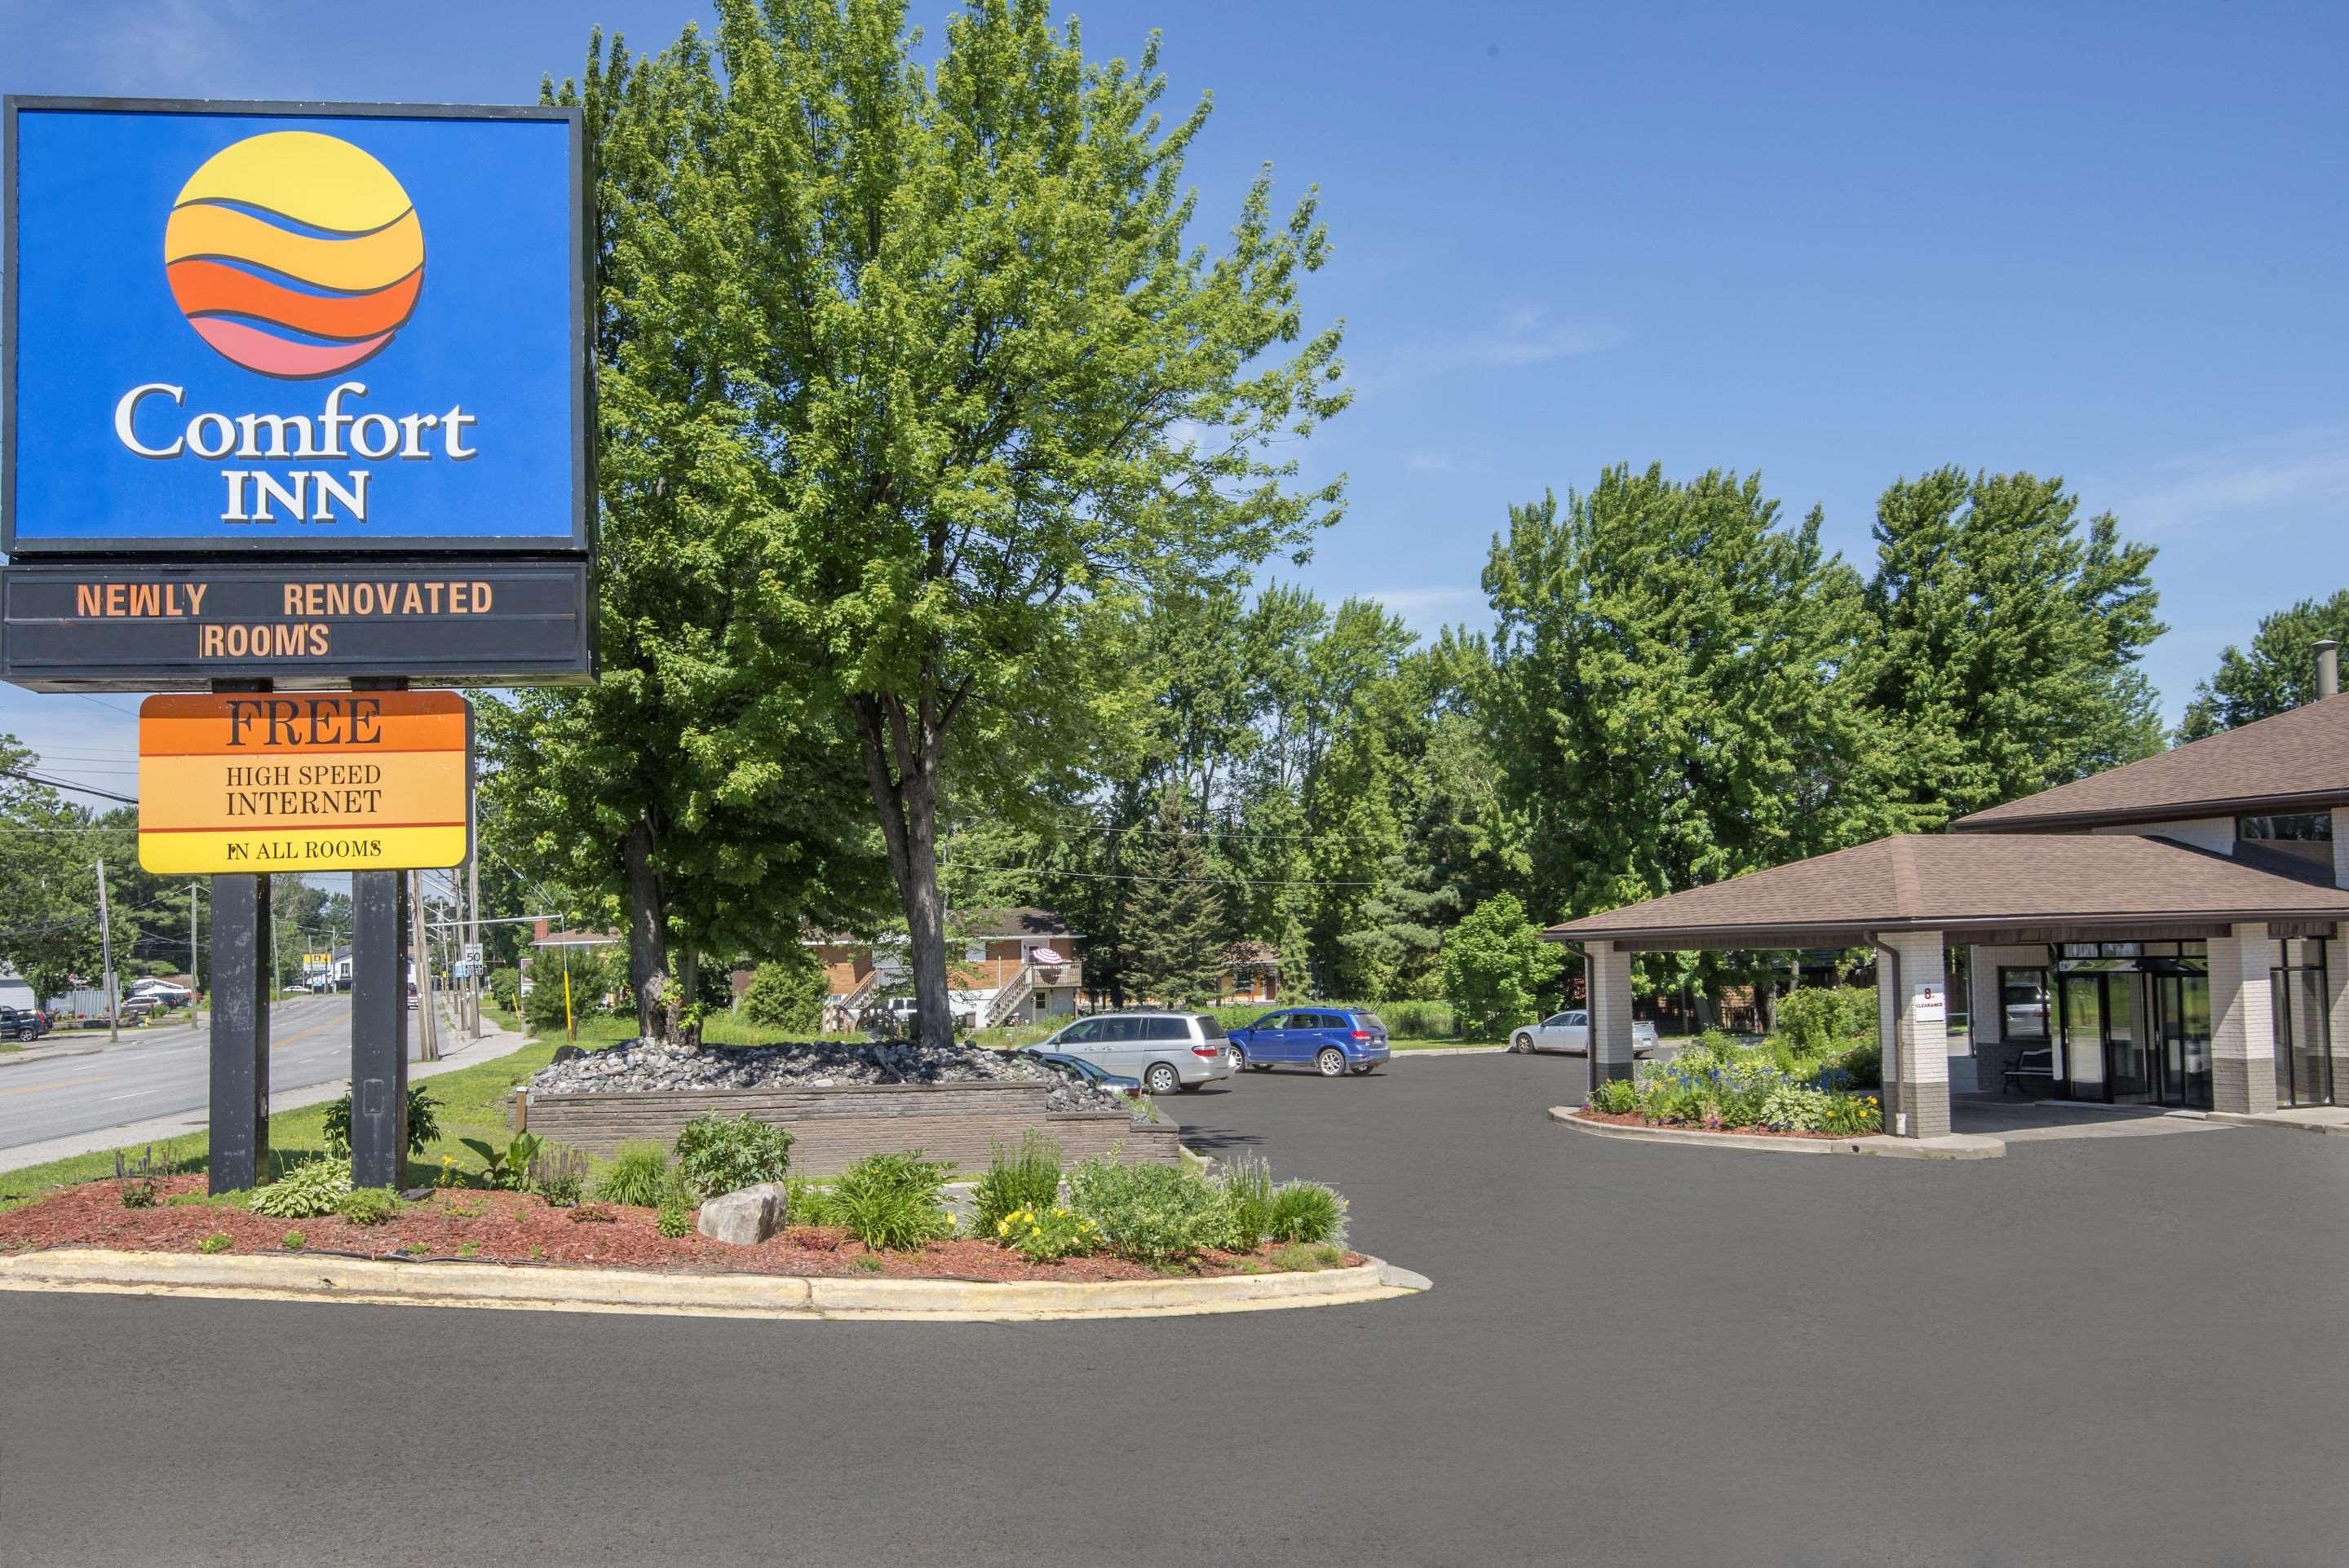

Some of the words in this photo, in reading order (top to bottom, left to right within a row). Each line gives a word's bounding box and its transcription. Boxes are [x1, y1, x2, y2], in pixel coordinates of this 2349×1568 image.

[114, 382, 477, 459] Comfort
[221, 470, 370, 522] INN
[77, 584, 207, 616] NEWLY
[284, 582, 493, 615] RENOVATED
[226, 698, 381, 746] FREE
[227, 766, 290, 787] HIGH
[299, 764, 381, 785] SPEED
[226, 789, 382, 815] INTERNET
[227, 842, 249, 860] IN
[256, 841, 299, 859] ALL
[305, 839, 382, 857] ROOMS
[467, 952, 480, 962] 50
